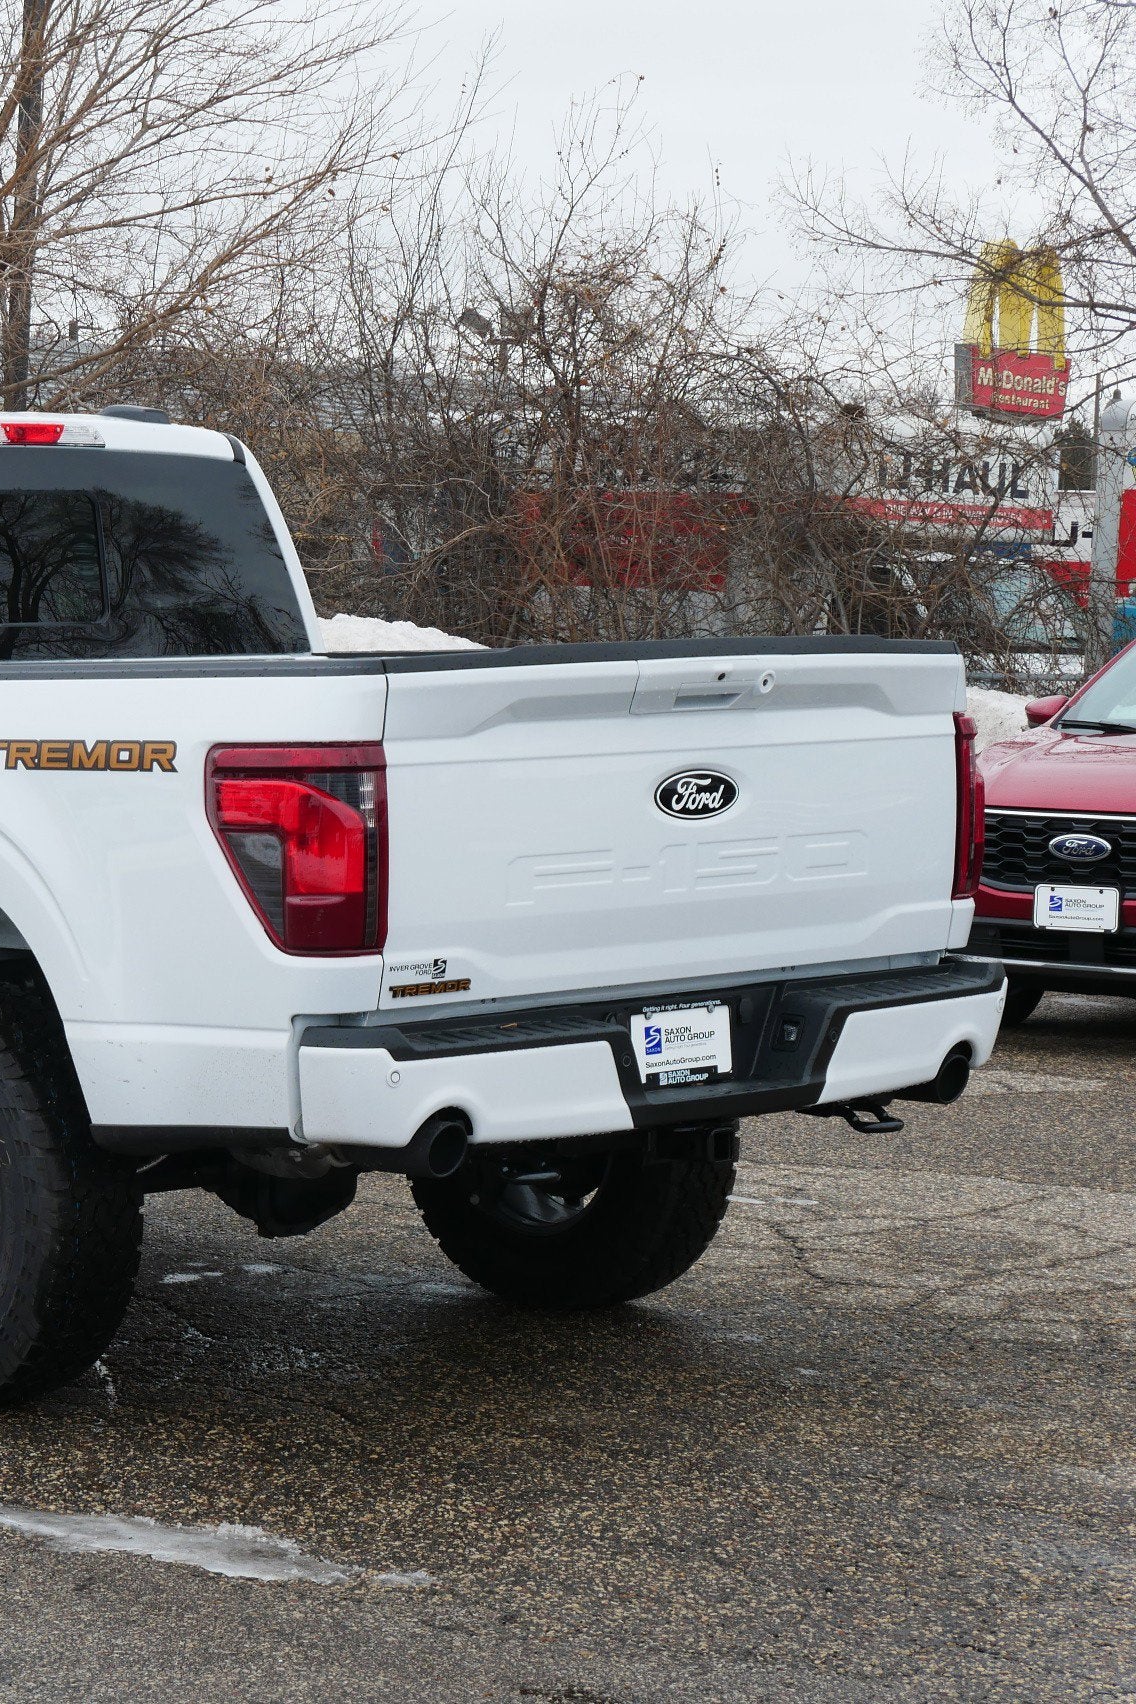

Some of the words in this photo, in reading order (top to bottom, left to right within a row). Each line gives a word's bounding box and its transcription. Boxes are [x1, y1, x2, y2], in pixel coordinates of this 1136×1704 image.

[977, 366, 1066, 397] McDonald's
[991, 391, 1050, 409] Restaurant
[671, 776, 726, 811] Ford
[1061, 839, 1095, 856] Ford
[505, 829, 869, 908] F-150
[389, 964, 409, 972] INVER
[410, 962, 433, 971] GROVE
[389, 977, 472, 999] TREMOR
[664, 1026, 692, 1036] SAXON
[665, 1034, 686, 1044] AUTO
[687, 1030, 716, 1041] GROUP
[645, 1054, 717, 1069] SaxonAutoGroup.com
[667, 1069, 691, 1078] SAXON
[668, 1075, 685, 1084] AUTO
[686, 1072, 709, 1082] GROUP
